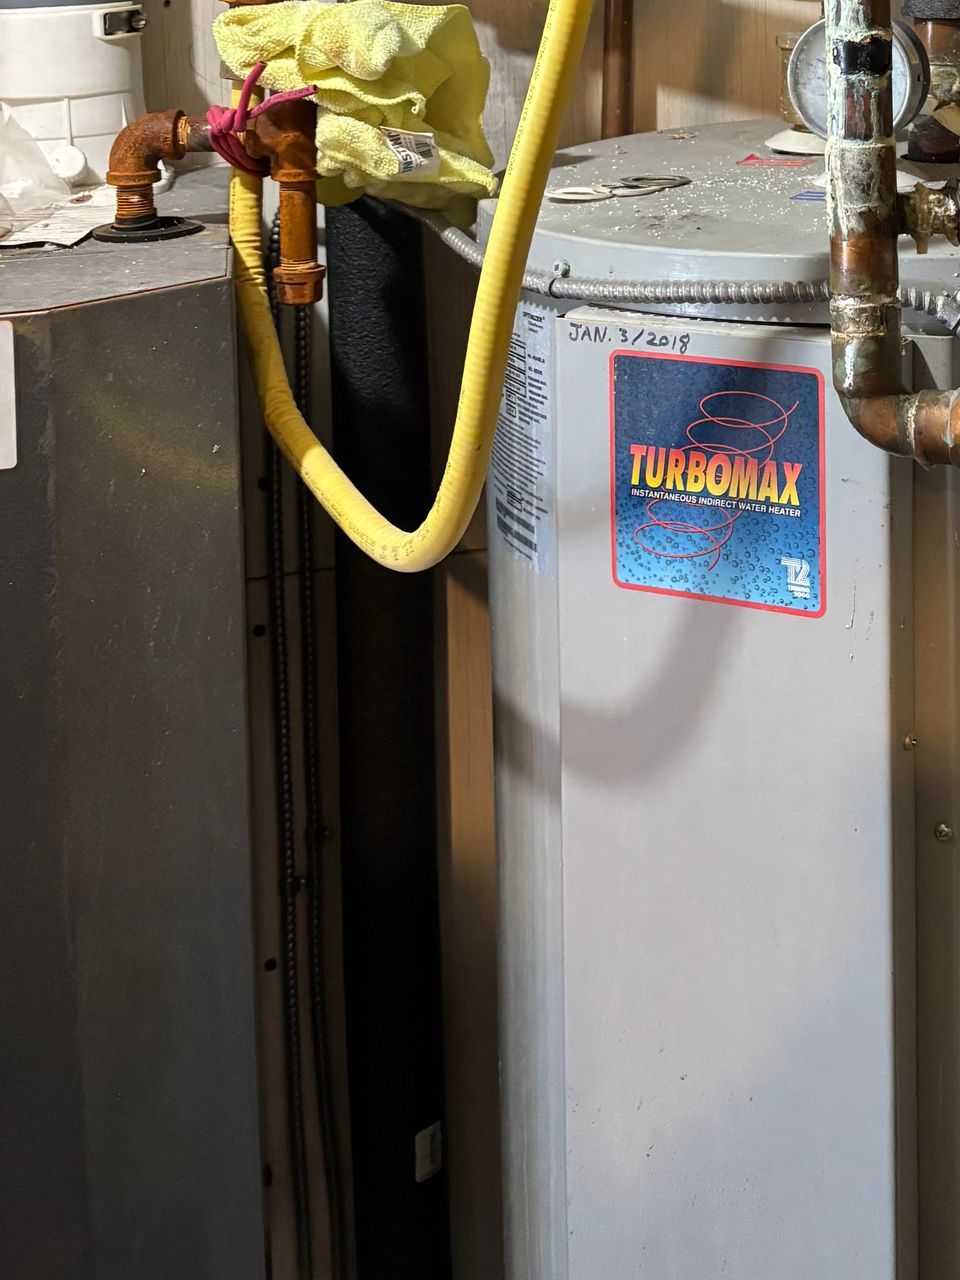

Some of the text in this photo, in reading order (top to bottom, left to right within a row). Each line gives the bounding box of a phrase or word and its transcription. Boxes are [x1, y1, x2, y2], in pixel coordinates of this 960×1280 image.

[568, 322, 612, 344] JAN.
[630, 444, 803, 506] TURBOMAX
[631, 488, 801, 518] INSTANTANEOUS INDIRECT WATER HEATER
